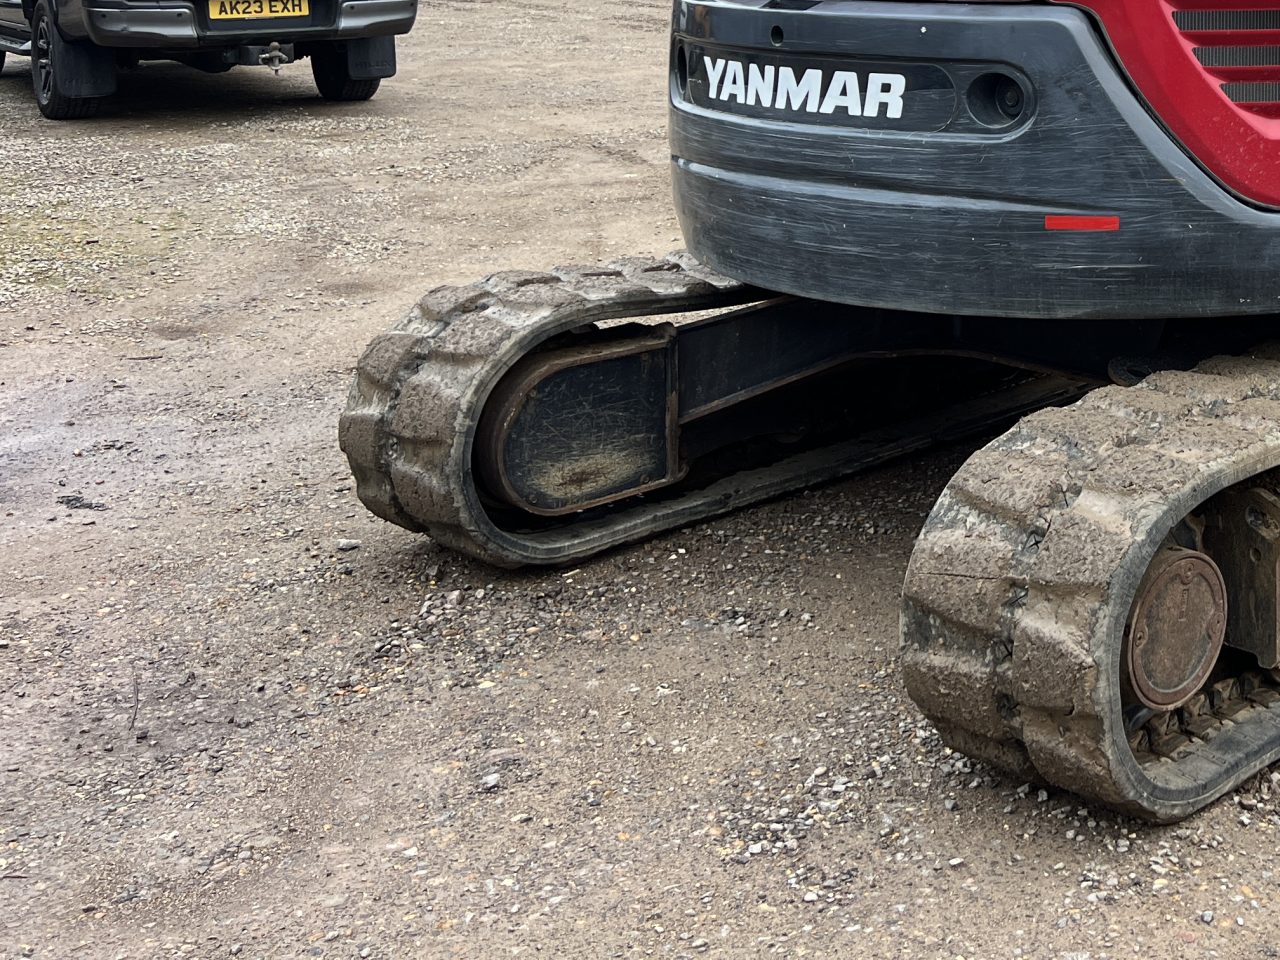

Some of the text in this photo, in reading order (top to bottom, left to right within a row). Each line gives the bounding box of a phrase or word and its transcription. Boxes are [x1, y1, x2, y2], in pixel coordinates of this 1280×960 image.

[218, 0, 302, 16] AK23 EXH
[703, 55, 906, 119] YANMAR
